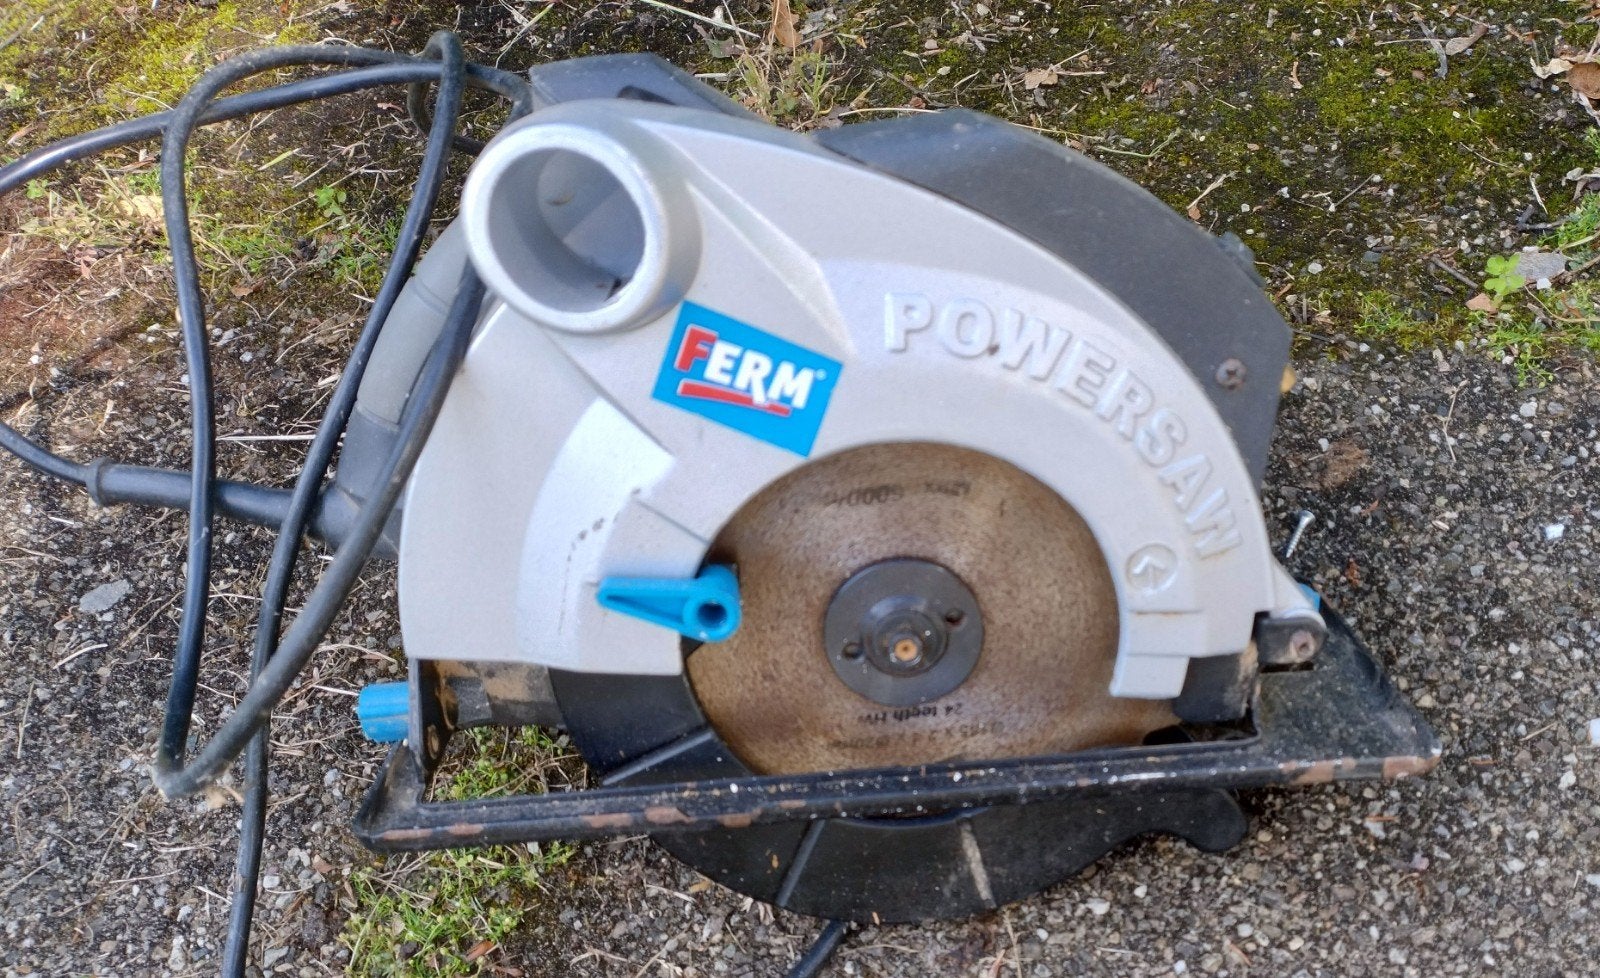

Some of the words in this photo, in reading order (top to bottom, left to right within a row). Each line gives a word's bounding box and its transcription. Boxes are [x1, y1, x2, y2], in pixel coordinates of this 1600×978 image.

[674, 323, 816, 410] FERM
[884, 292, 1241, 561] POWERSAW
[893, 704, 937, 722] teeth
